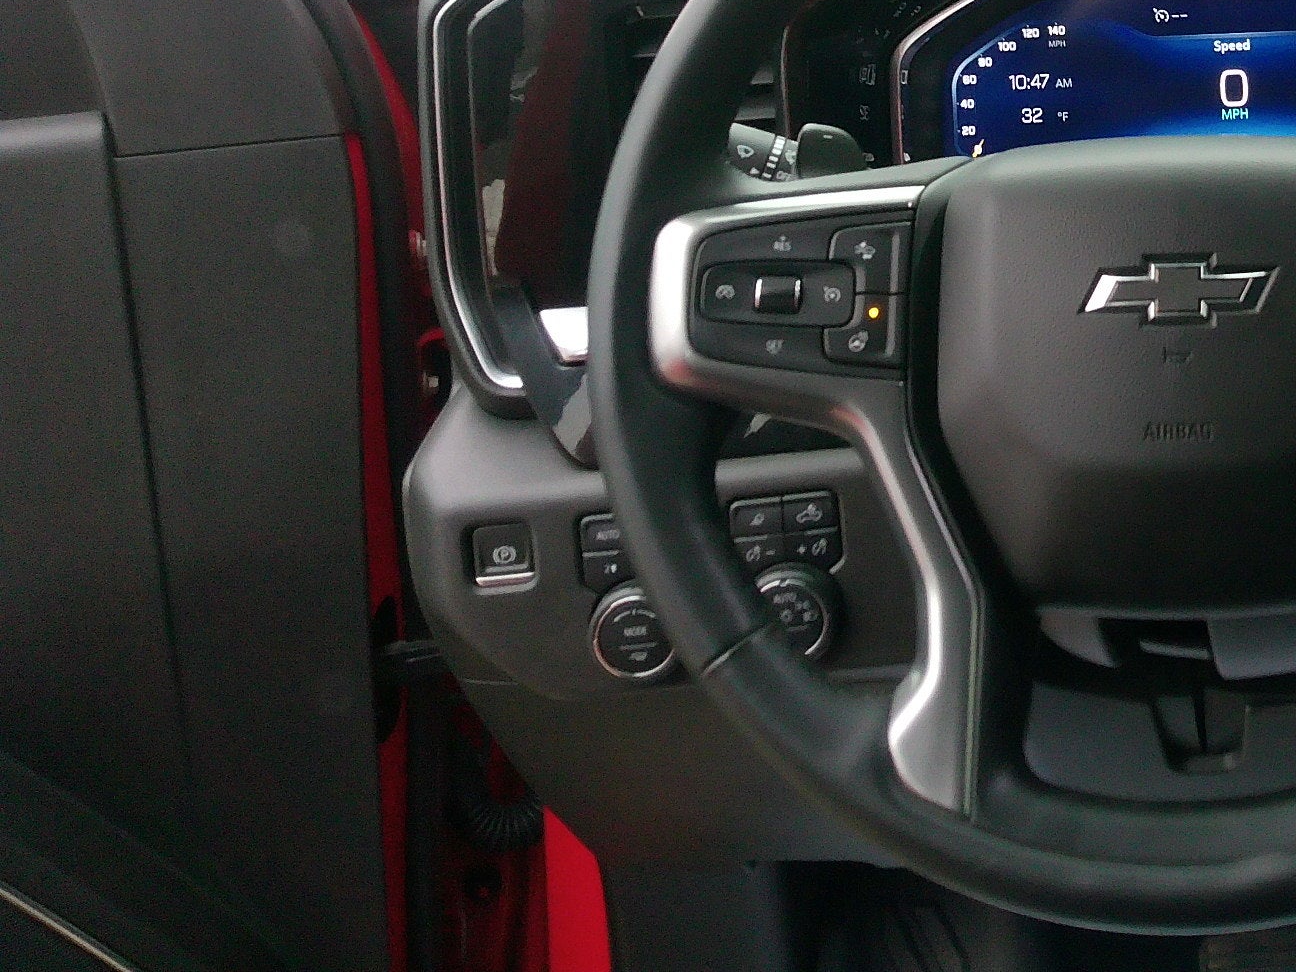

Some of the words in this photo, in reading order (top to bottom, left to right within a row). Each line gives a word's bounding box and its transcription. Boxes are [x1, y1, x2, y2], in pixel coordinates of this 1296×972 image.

[1022, 28, 1040, 38] 120
[1047, 25, 1066, 36] 140
[998, 41, 1017, 52] 100
[1048, 40, 1066, 48] MPH
[1213, 39, 1251, 54] Speed
[978, 56, 993, 67] 80
[1008, 73, 1050, 90] 10:47
[1055, 78, 1073, 88] AM
[1219, 68, 1249, 107] 0
[960, 98, 975, 109] 40
[1021, 108, 1043, 124] 32
[1057, 111, 1069, 121] °F
[1221, 108, 1249, 120] MPH
[961, 125, 976, 136] 20
